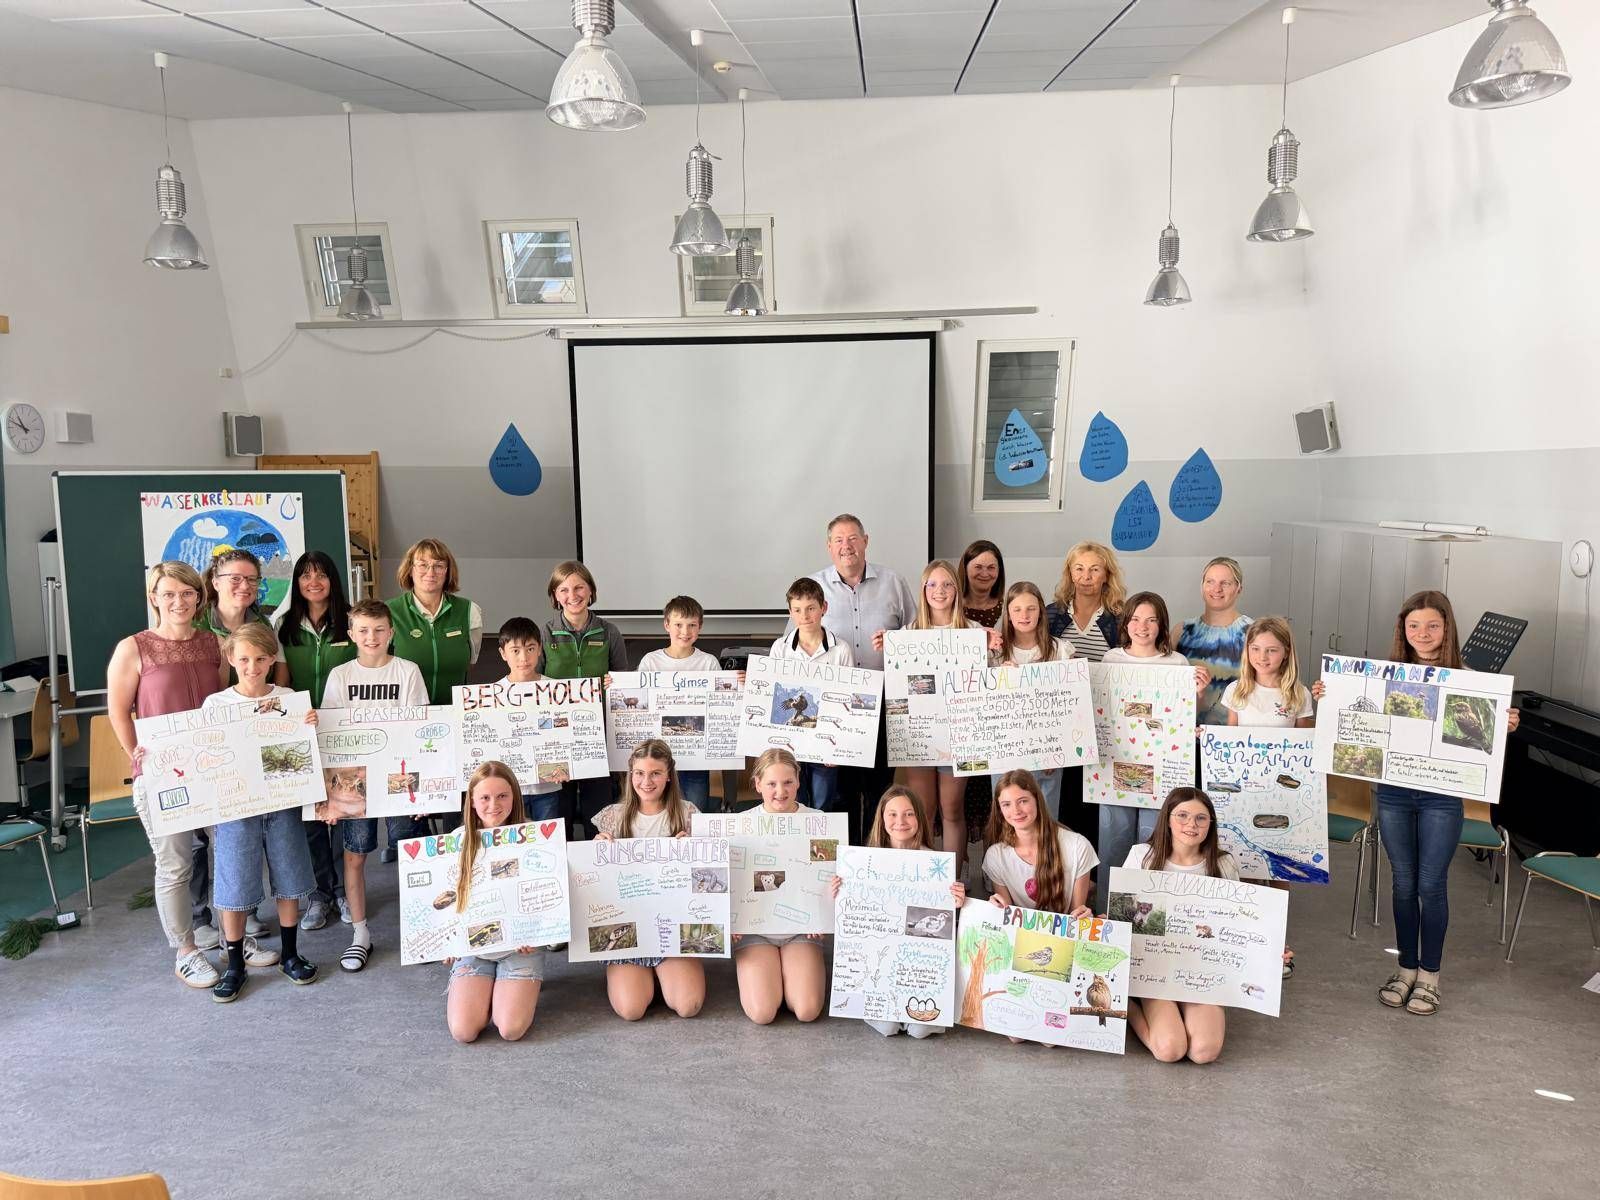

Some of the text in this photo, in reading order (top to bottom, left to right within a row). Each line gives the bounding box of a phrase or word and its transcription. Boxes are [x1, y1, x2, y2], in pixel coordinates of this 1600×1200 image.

[886, 630, 981, 665] Seesaibling
[640, 672, 709, 691] DIE Gämse
[756, 656, 873, 686] STEINADLER
[943, 661, 1090, 695] ALPENSALAMANDER
[348, 683, 400, 701] PUMA
[462, 678, 603, 711] BERG-MOLCH
[1051, 697, 1080, 709] Meter
[353, 706, 427, 722] GRASFROSCH
[1025, 719, 1062, 731] Mensch
[1205, 733, 1314, 756] Regenbogenforell
[709, 815, 828, 838] HERMELIN
[595, 838, 729, 864] RINGELNATTER
[1003, 907, 1114, 943] BAUMPIEPER
